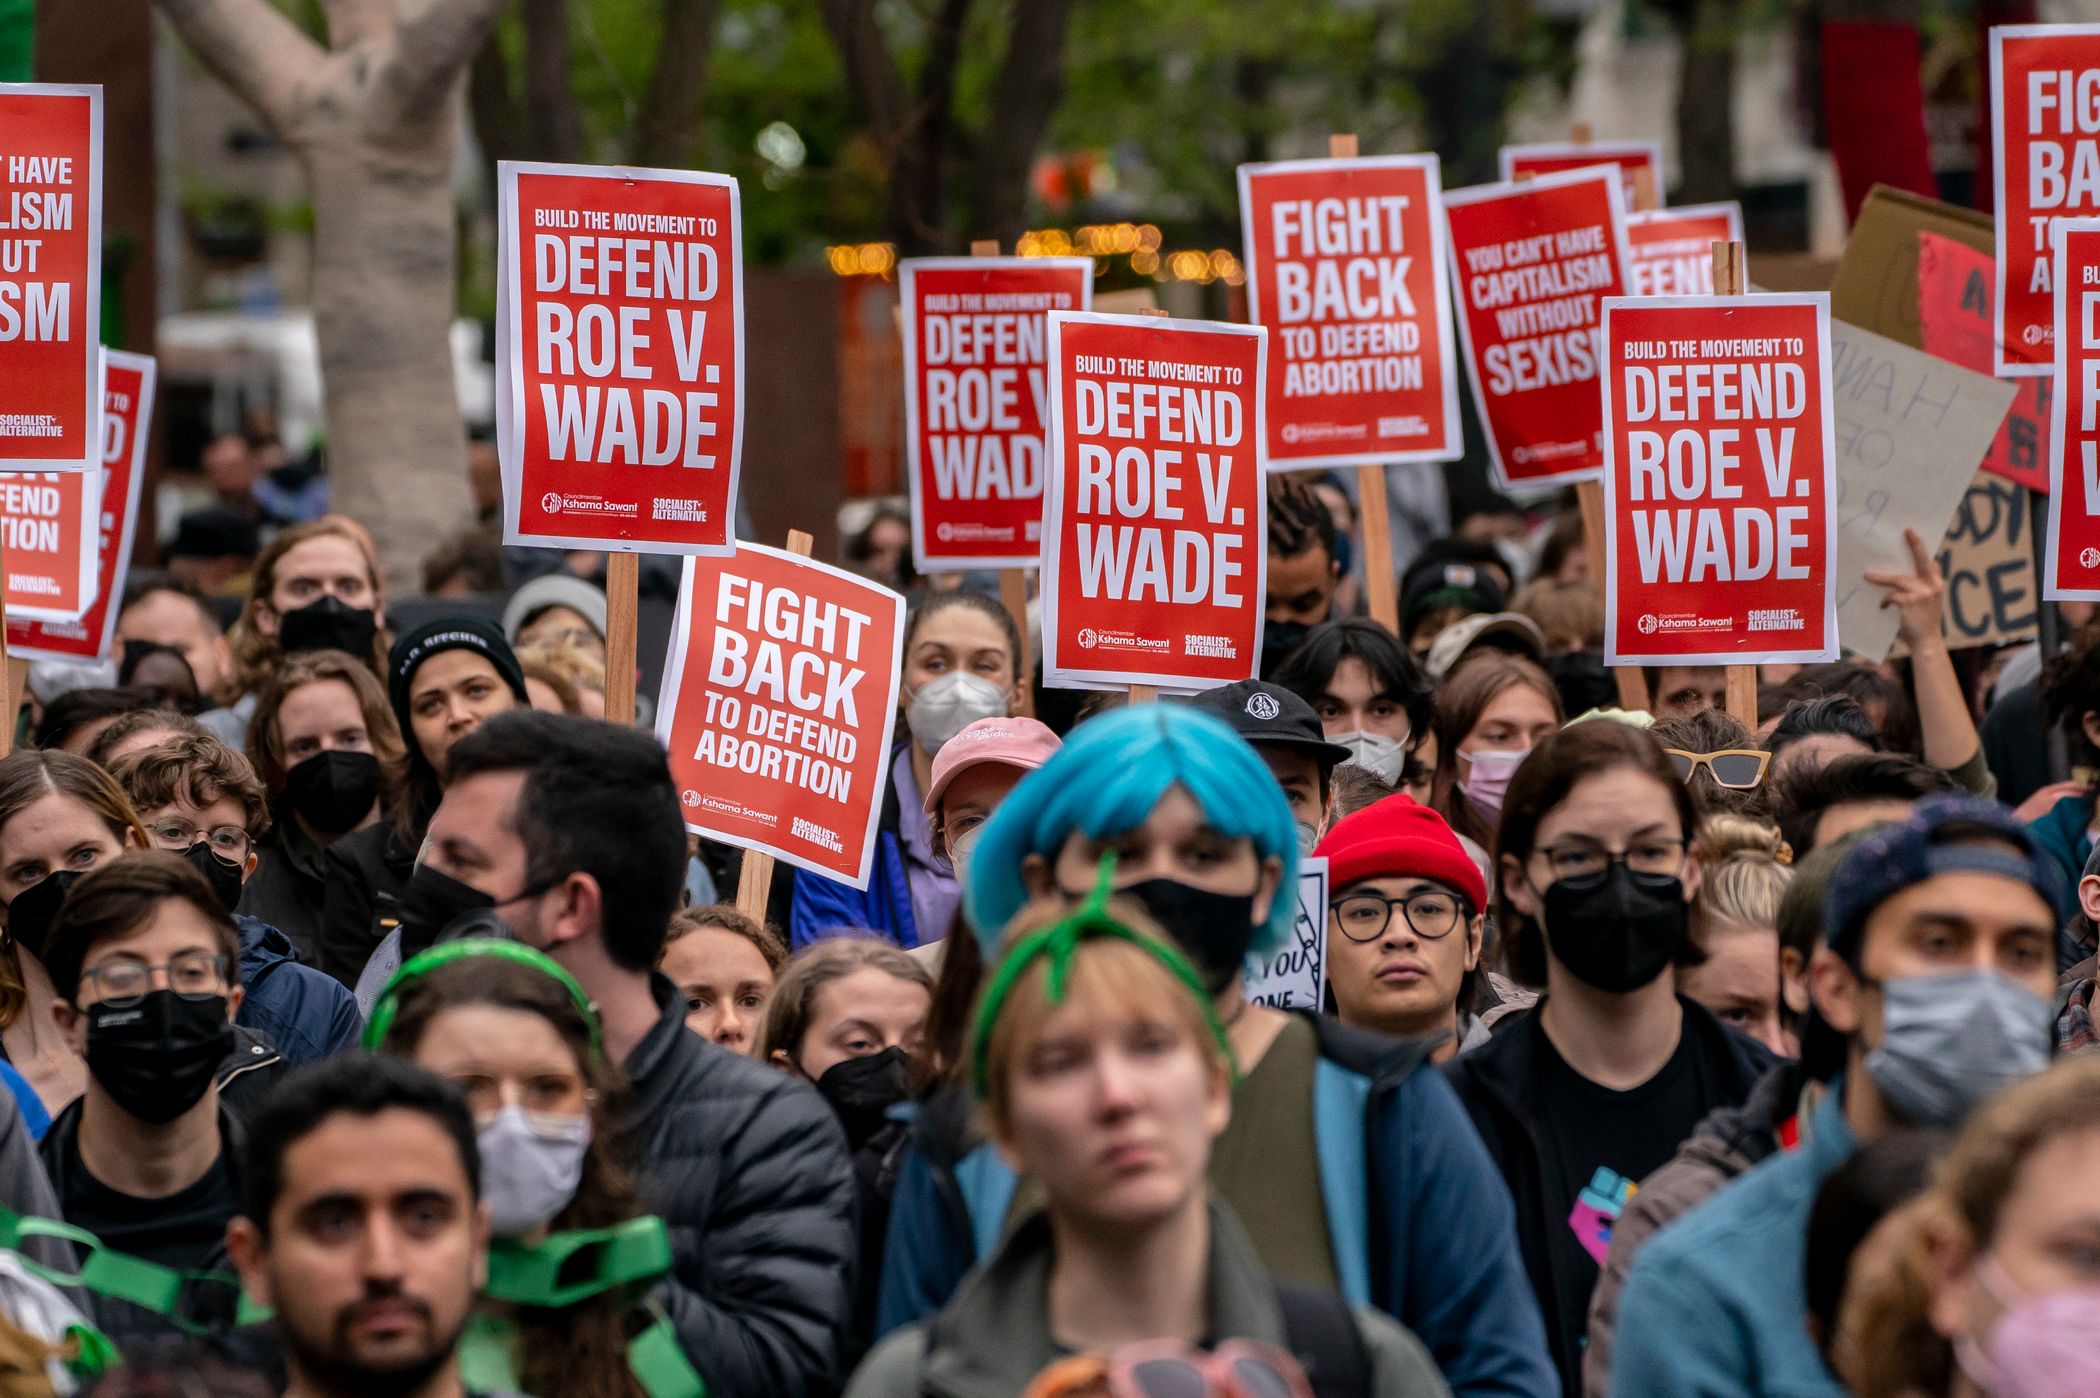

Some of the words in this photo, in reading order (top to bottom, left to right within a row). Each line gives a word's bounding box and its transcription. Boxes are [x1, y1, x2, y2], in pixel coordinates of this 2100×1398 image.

[2027, 68, 2100, 135] FIG
[9, 156, 73, 185] HAVE
[2029, 139, 2100, 209] BA
[535, 209, 579, 230] BUILD
[582, 211, 610, 231] THE
[614, 213, 696, 235] MOVEMENT
[699, 217, 717, 237] TO
[1272, 195, 1409, 259] FIGHT
[2, 239, 42, 273] UT
[535, 234, 718, 301] DEFEND
[1465, 242, 1503, 275] YOU
[1505, 235, 1555, 267] CAN'T
[1558, 224, 1606, 257] HAVE
[1275, 256, 1417, 324] BACK
[1470, 253, 1614, 310] CAPITALISM
[0, 281, 70, 342] SM
[1495, 294, 1596, 341] WITHOUT
[536, 301, 652, 380] ROE
[667, 309, 720, 383] V.
[925, 313, 1047, 366] DEFEN
[1281, 328, 1317, 361] TO
[1321, 321, 1420, 359] DEFEND
[1483, 329, 1601, 397] SEXIS
[1624, 341, 1667, 360] BUILD
[1670, 339, 1698, 358] THE
[1700, 338, 1781, 358] MOVEMENT
[1783, 337, 1803, 356] TO
[1075, 354, 1116, 375] BUILD
[1119, 357, 1145, 377] THE
[1148, 359, 1222, 383] MOVEMENT
[1224, 366, 1242, 385] TO
[1282, 355, 1423, 398] ABORTION
[1624, 362, 1806, 423] DEFEND
[0, 414, 52, 426] SOCIALIST
[926, 368, 1020, 431] ROE
[1075, 379, 1242, 447] DEFEND
[0, 425, 63, 437] ALTERNATIVE
[540, 383, 718, 469] WADE
[928, 435, 1044, 500] WAD
[1077, 443, 1184, 520] ROE
[1196, 452, 1245, 526] V.
[1627, 428, 1743, 500] ROE
[1755, 427, 1810, 498] V.
[0, 484, 60, 517] END
[563, 499, 602, 511] Kshama
[604, 501, 637, 512] Sawant
[652, 508, 706, 522] ALTERNATIVE
[653, 498, 699, 510] SOCIALIST
[1, 517, 59, 553] TION
[1632, 505, 1810, 584] WADE
[1076, 522, 1243, 609] WADE
[716, 572, 871, 662] FIGHT
[1658, 617, 1696, 628] Kshama
[1698, 617, 1733, 627] Sawant
[1748, 609, 1795, 621] SOCIALIST
[1748, 619, 1805, 632] ALTERNATIVE
[1098, 634, 1135, 646] Kshama
[1136, 637, 1170, 648] Sawant
[1185, 634, 1230, 647] SOCIALIST
[1185, 645, 1236, 659] ALTERNATIVE
[708, 626, 866, 728] BACK
[705, 690, 741, 730] TO
[747, 704, 858, 764] DEFEND
[694, 731, 852, 804] ABORTION
[702, 798, 741, 814] Kshama
[742, 807, 778, 823] Sawant
[793, 816, 837, 840] SOCIALIST
[791, 826, 843, 853] ALTERNATIVE
